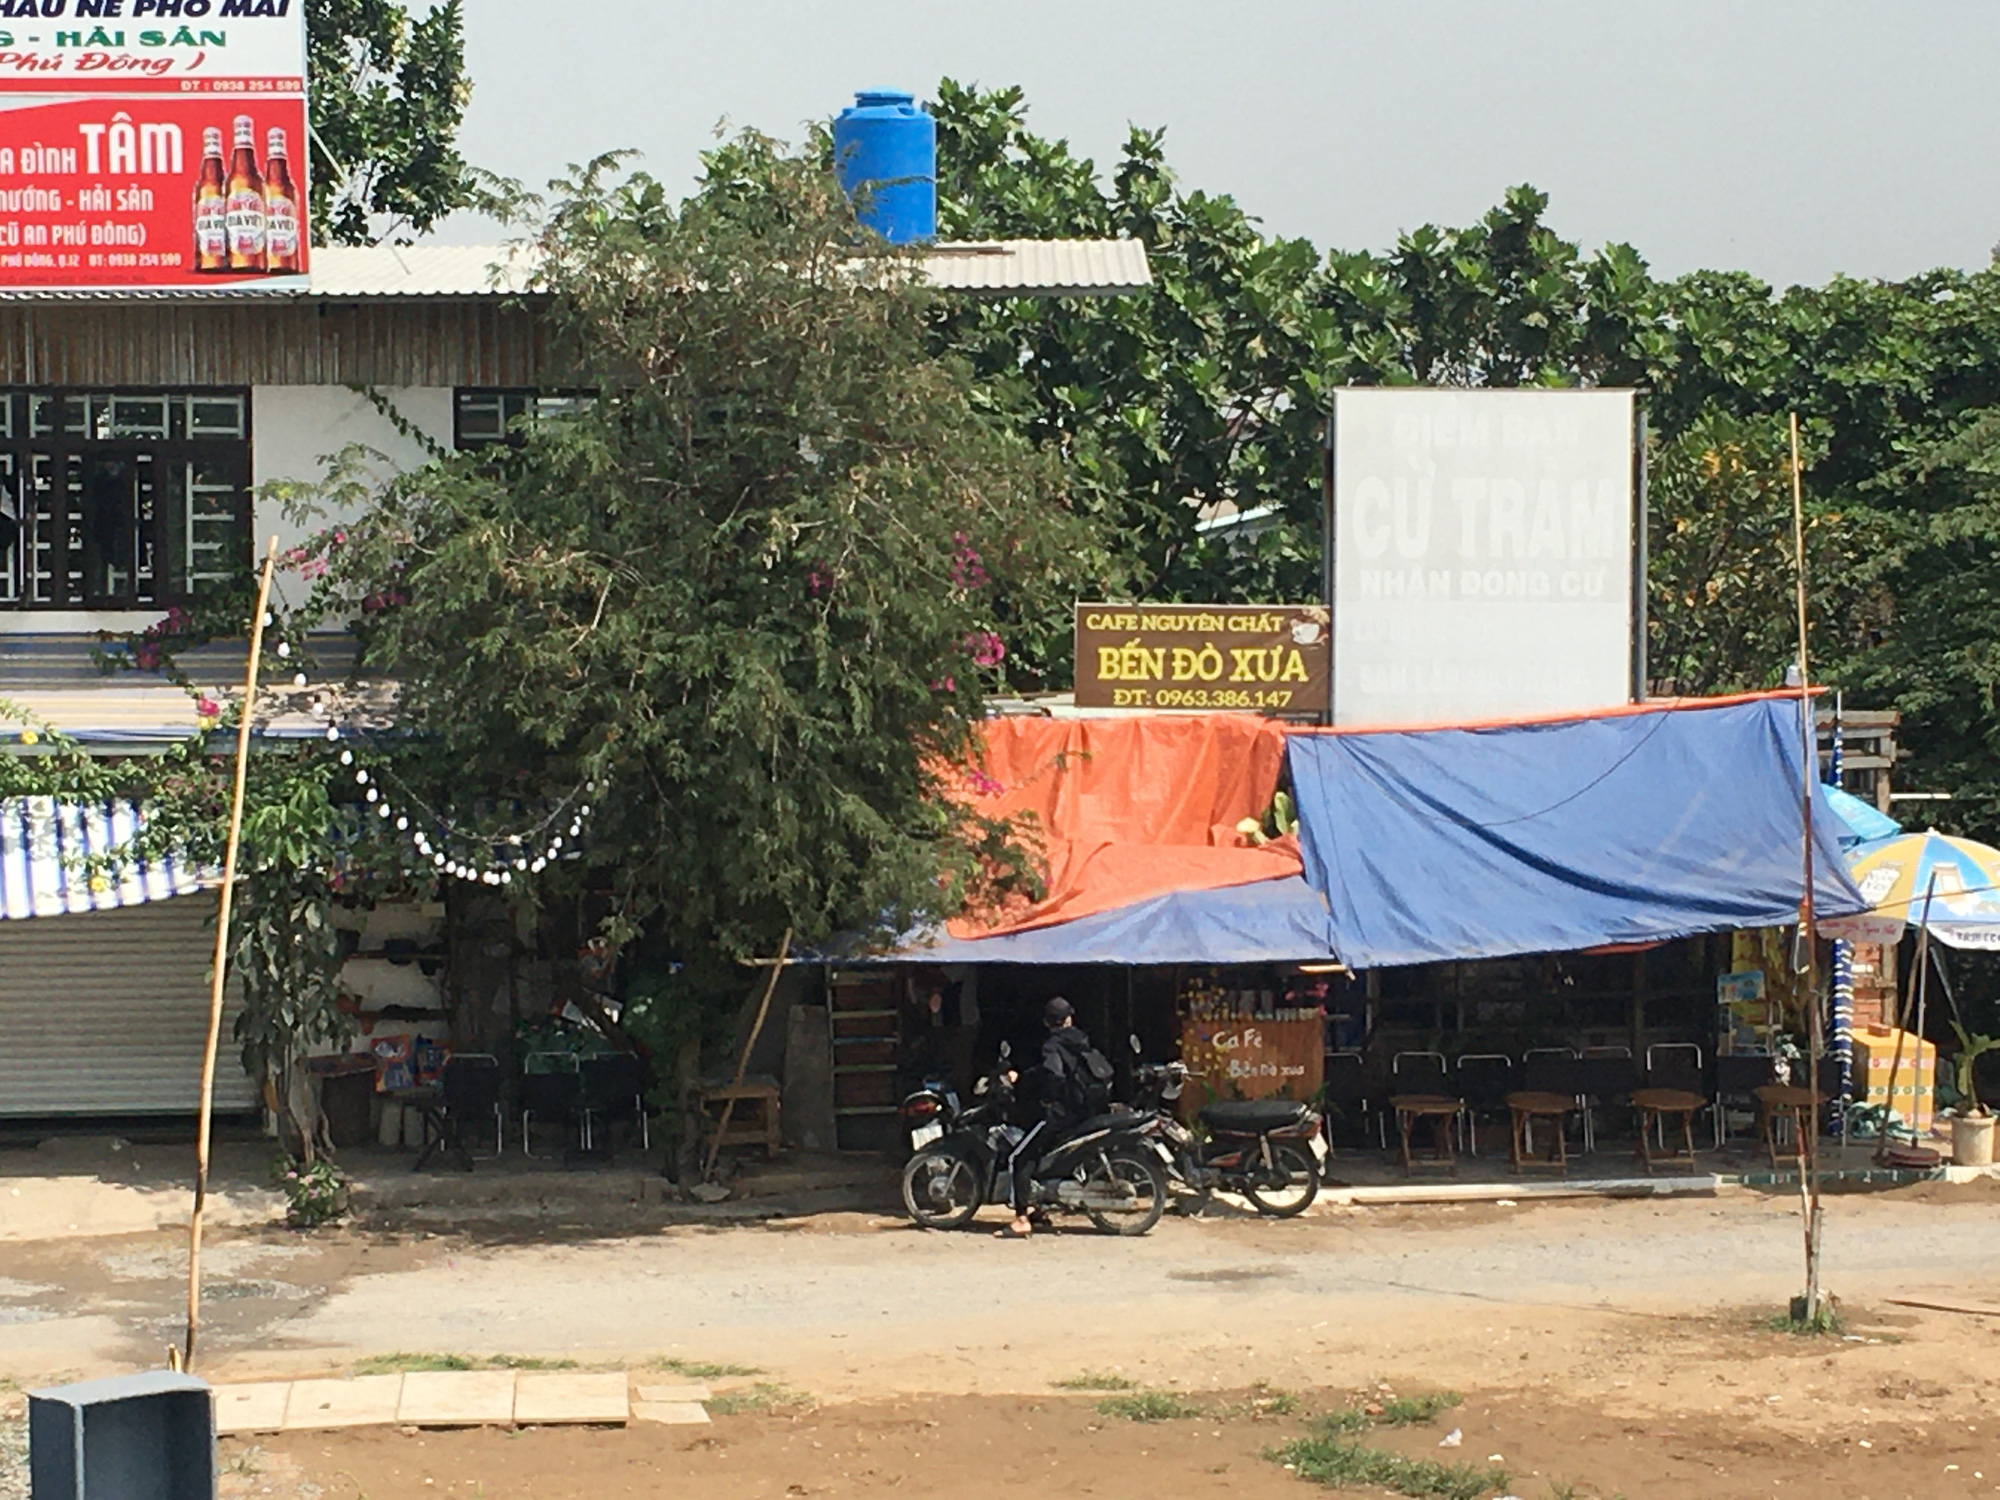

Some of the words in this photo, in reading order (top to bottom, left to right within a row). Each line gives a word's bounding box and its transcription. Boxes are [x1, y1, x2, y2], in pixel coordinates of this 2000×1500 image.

[56, 26, 125, 47] HẢI
[139, 26, 226, 47] SẢN
[20, 141, 76, 174] ĐÌNH
[79, 183, 111, 211] HẢI
[117, 183, 153, 211] SẢN
[24, 224, 47, 245] AN
[52, 219, 86, 246] PHÚ
[1086, 613, 1138, 631] CAFE
[1141, 612, 1225, 632] NGUYÊN
[1228, 611, 1285, 632] CHẤT
[1097, 637, 1166, 680] BẾN
[1171, 642, 1224, 681] ĐÒ
[1228, 645, 1310, 682] XƯA
[1113, 689, 1151, 706] ĐT:
[1155, 689, 1292, 707] 0963.386.147
